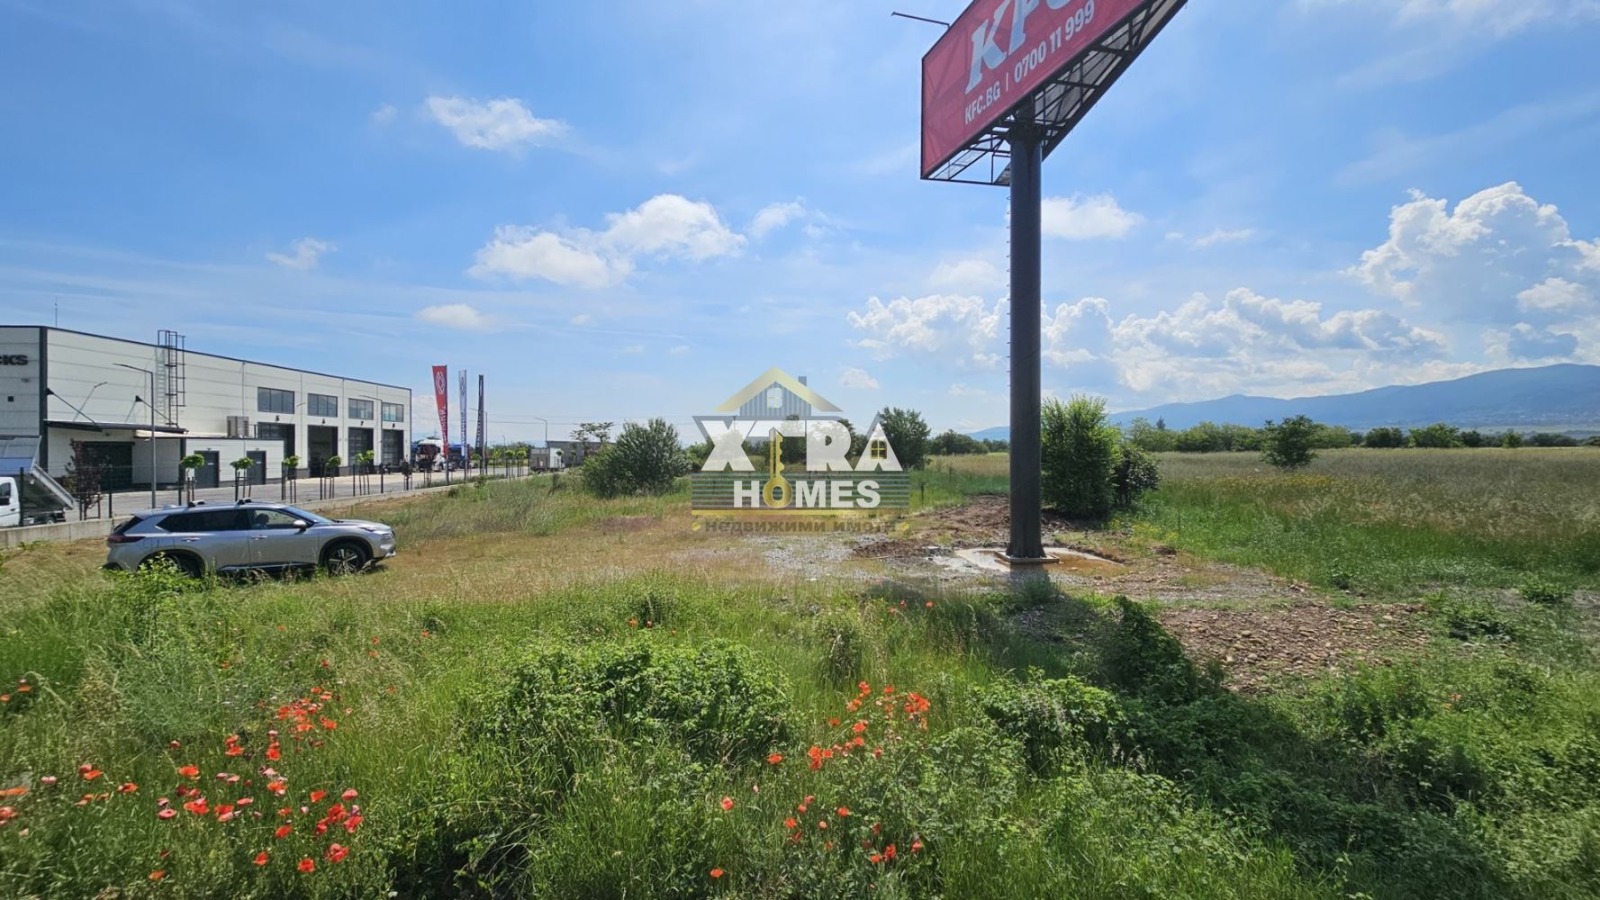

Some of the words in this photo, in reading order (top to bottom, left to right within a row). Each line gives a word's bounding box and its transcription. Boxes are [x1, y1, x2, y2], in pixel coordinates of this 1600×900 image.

[965, 0, 1070, 95] KF
[965, 81, 1000, 125] KFC.BG
[1014, 40, 1047, 83] 0700
[1050, 27, 1062, 53] 11
[1065, 0, 1095, 40] 999
